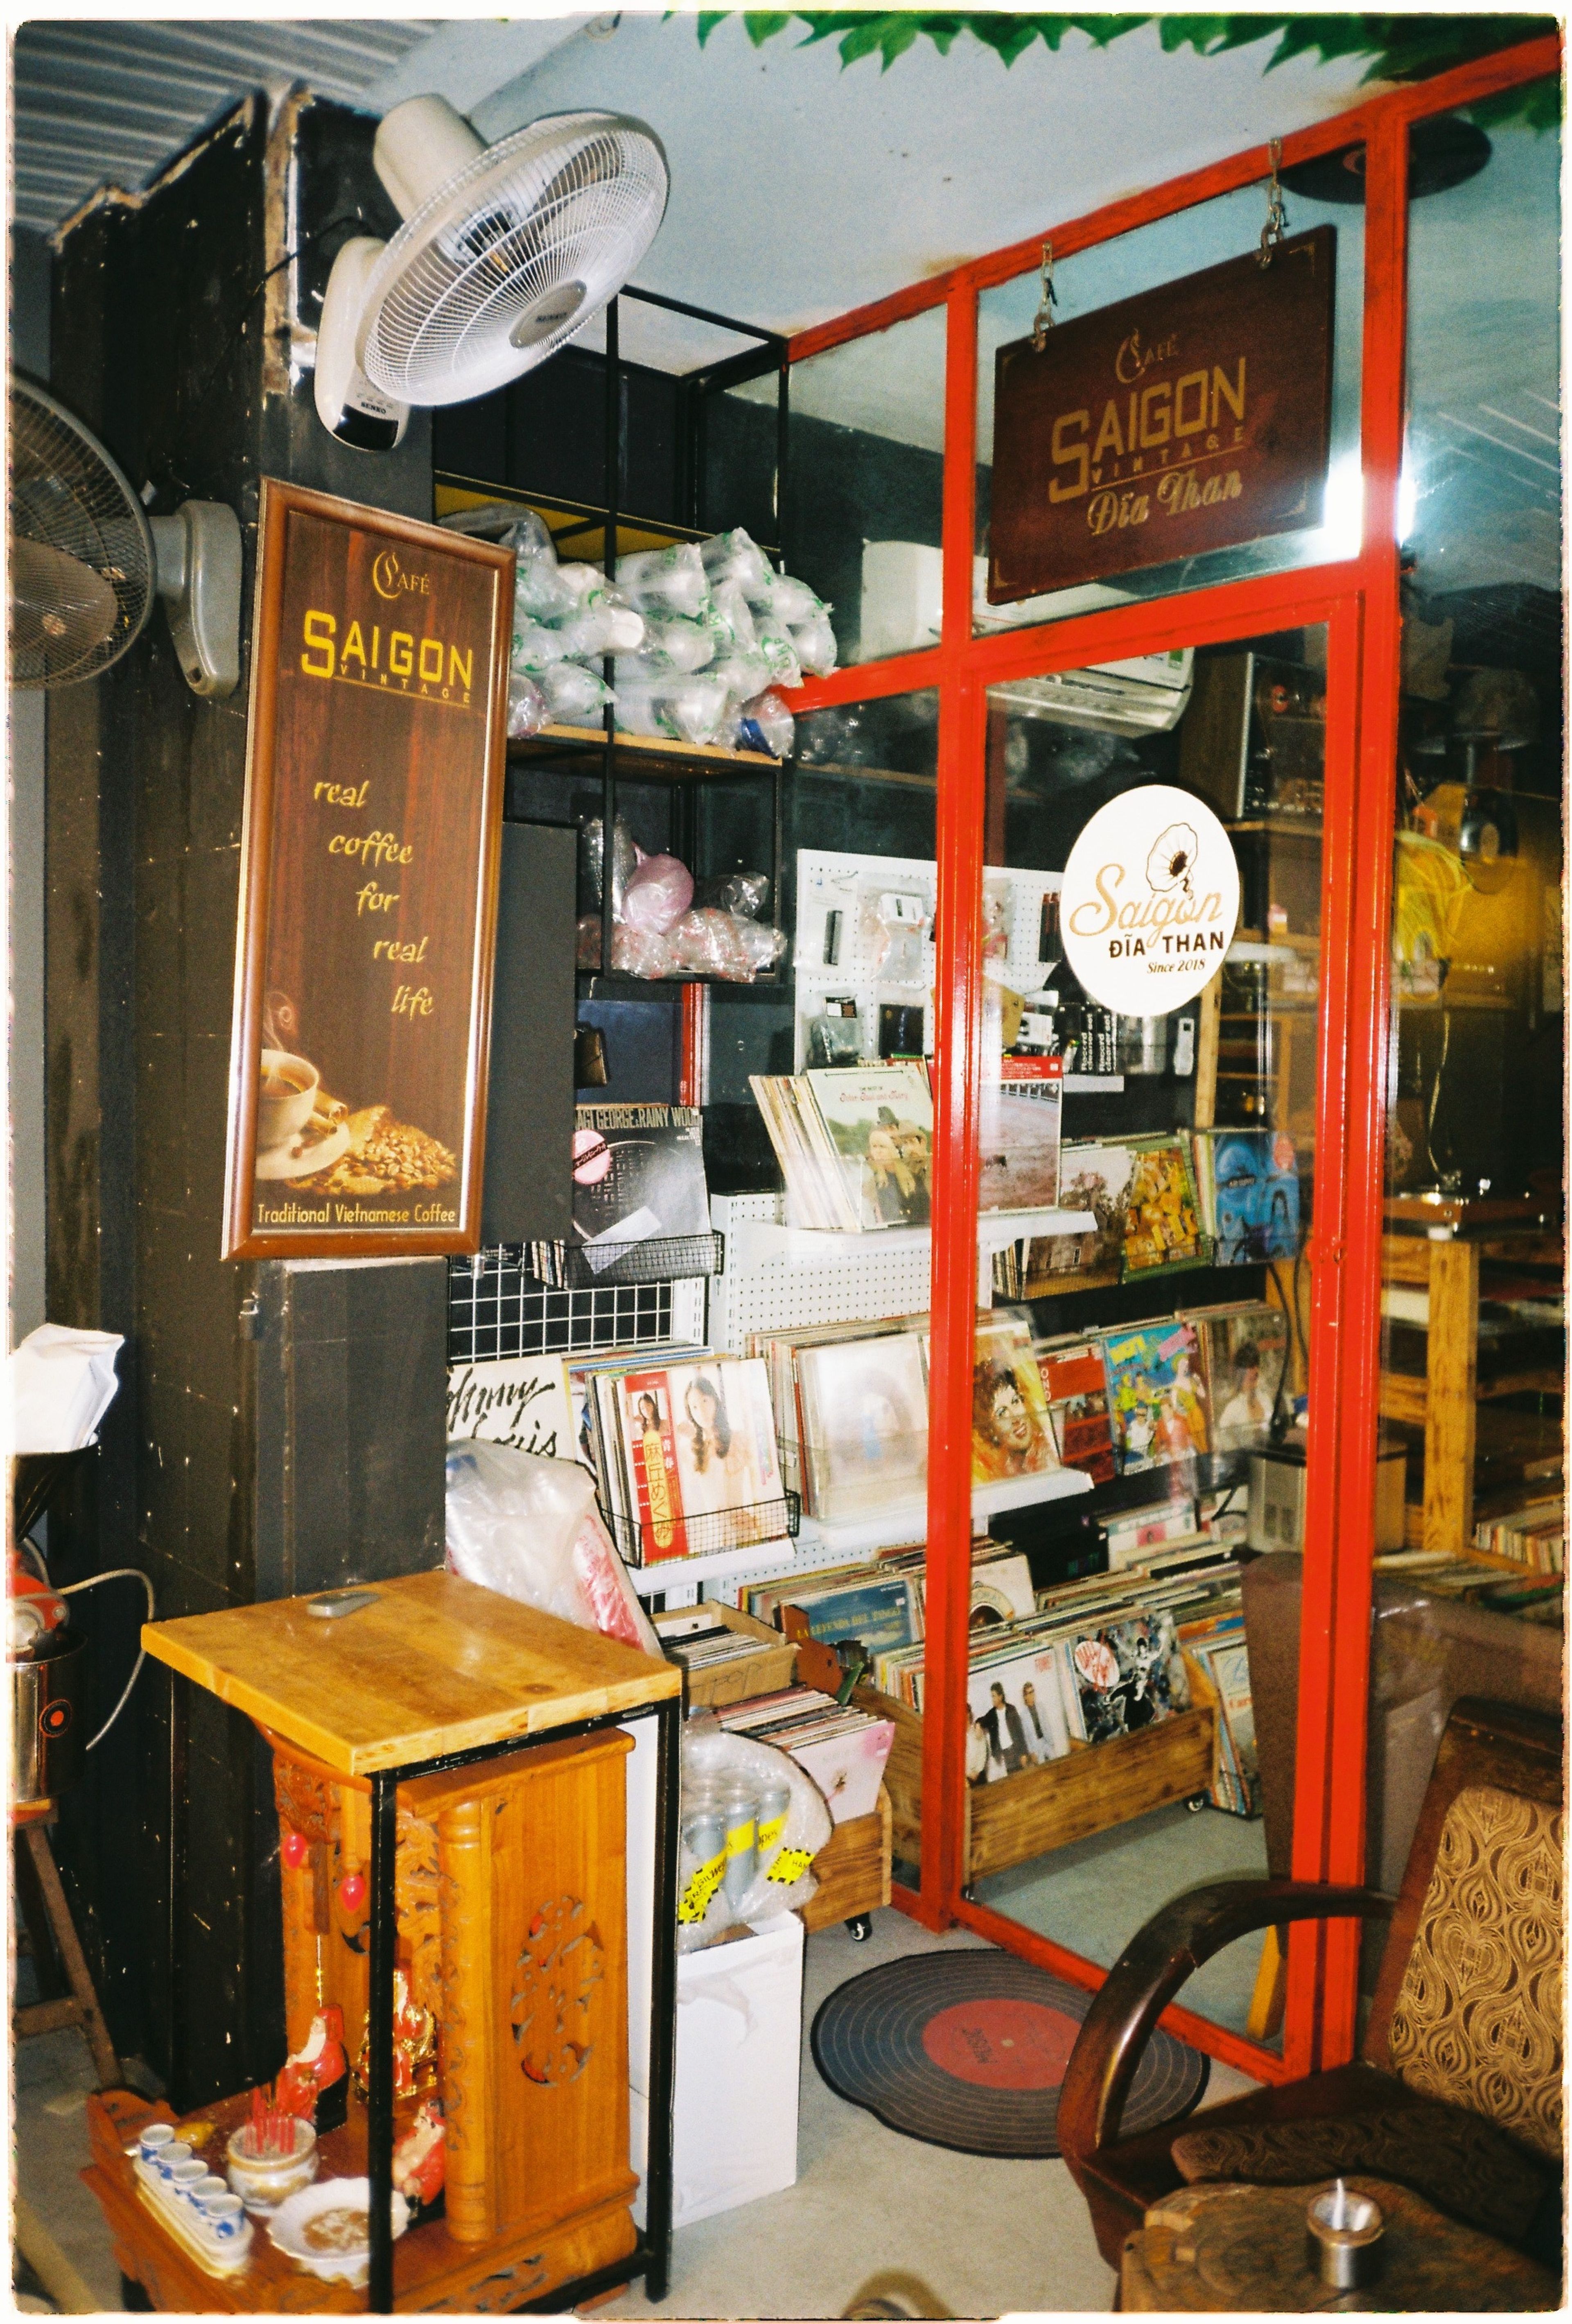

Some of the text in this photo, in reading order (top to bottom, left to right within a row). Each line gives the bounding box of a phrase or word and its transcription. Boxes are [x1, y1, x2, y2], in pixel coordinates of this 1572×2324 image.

[1116, 328, 1179, 384] CAFÉ
[1048, 356, 1246, 504] SAIGON
[1091, 426, 1245, 484] VINTAGE
[1156, 468, 1243, 516] Than
[372, 550, 430, 600] CAFÉ
[301, 610, 473, 690] SAIGON
[340, 664, 470, 704] VINTAGE
[314, 780, 370, 808] real
[328, 831, 413, 867] coffee
[356, 881, 400, 917] for
[1069, 863, 1224, 948] Saigon
[373, 936, 429, 963] real
[1109, 931, 1225, 958] ĐĨA THAN
[1147, 959, 1206, 974] Since 2018
[391, 985, 433, 1020] life
[596, 1108, 635, 1130] GEORGE
[638, 1107, 669, 1128] RAINY
[257, 1202, 456, 1223] Traditional Vietnamese Coffee
